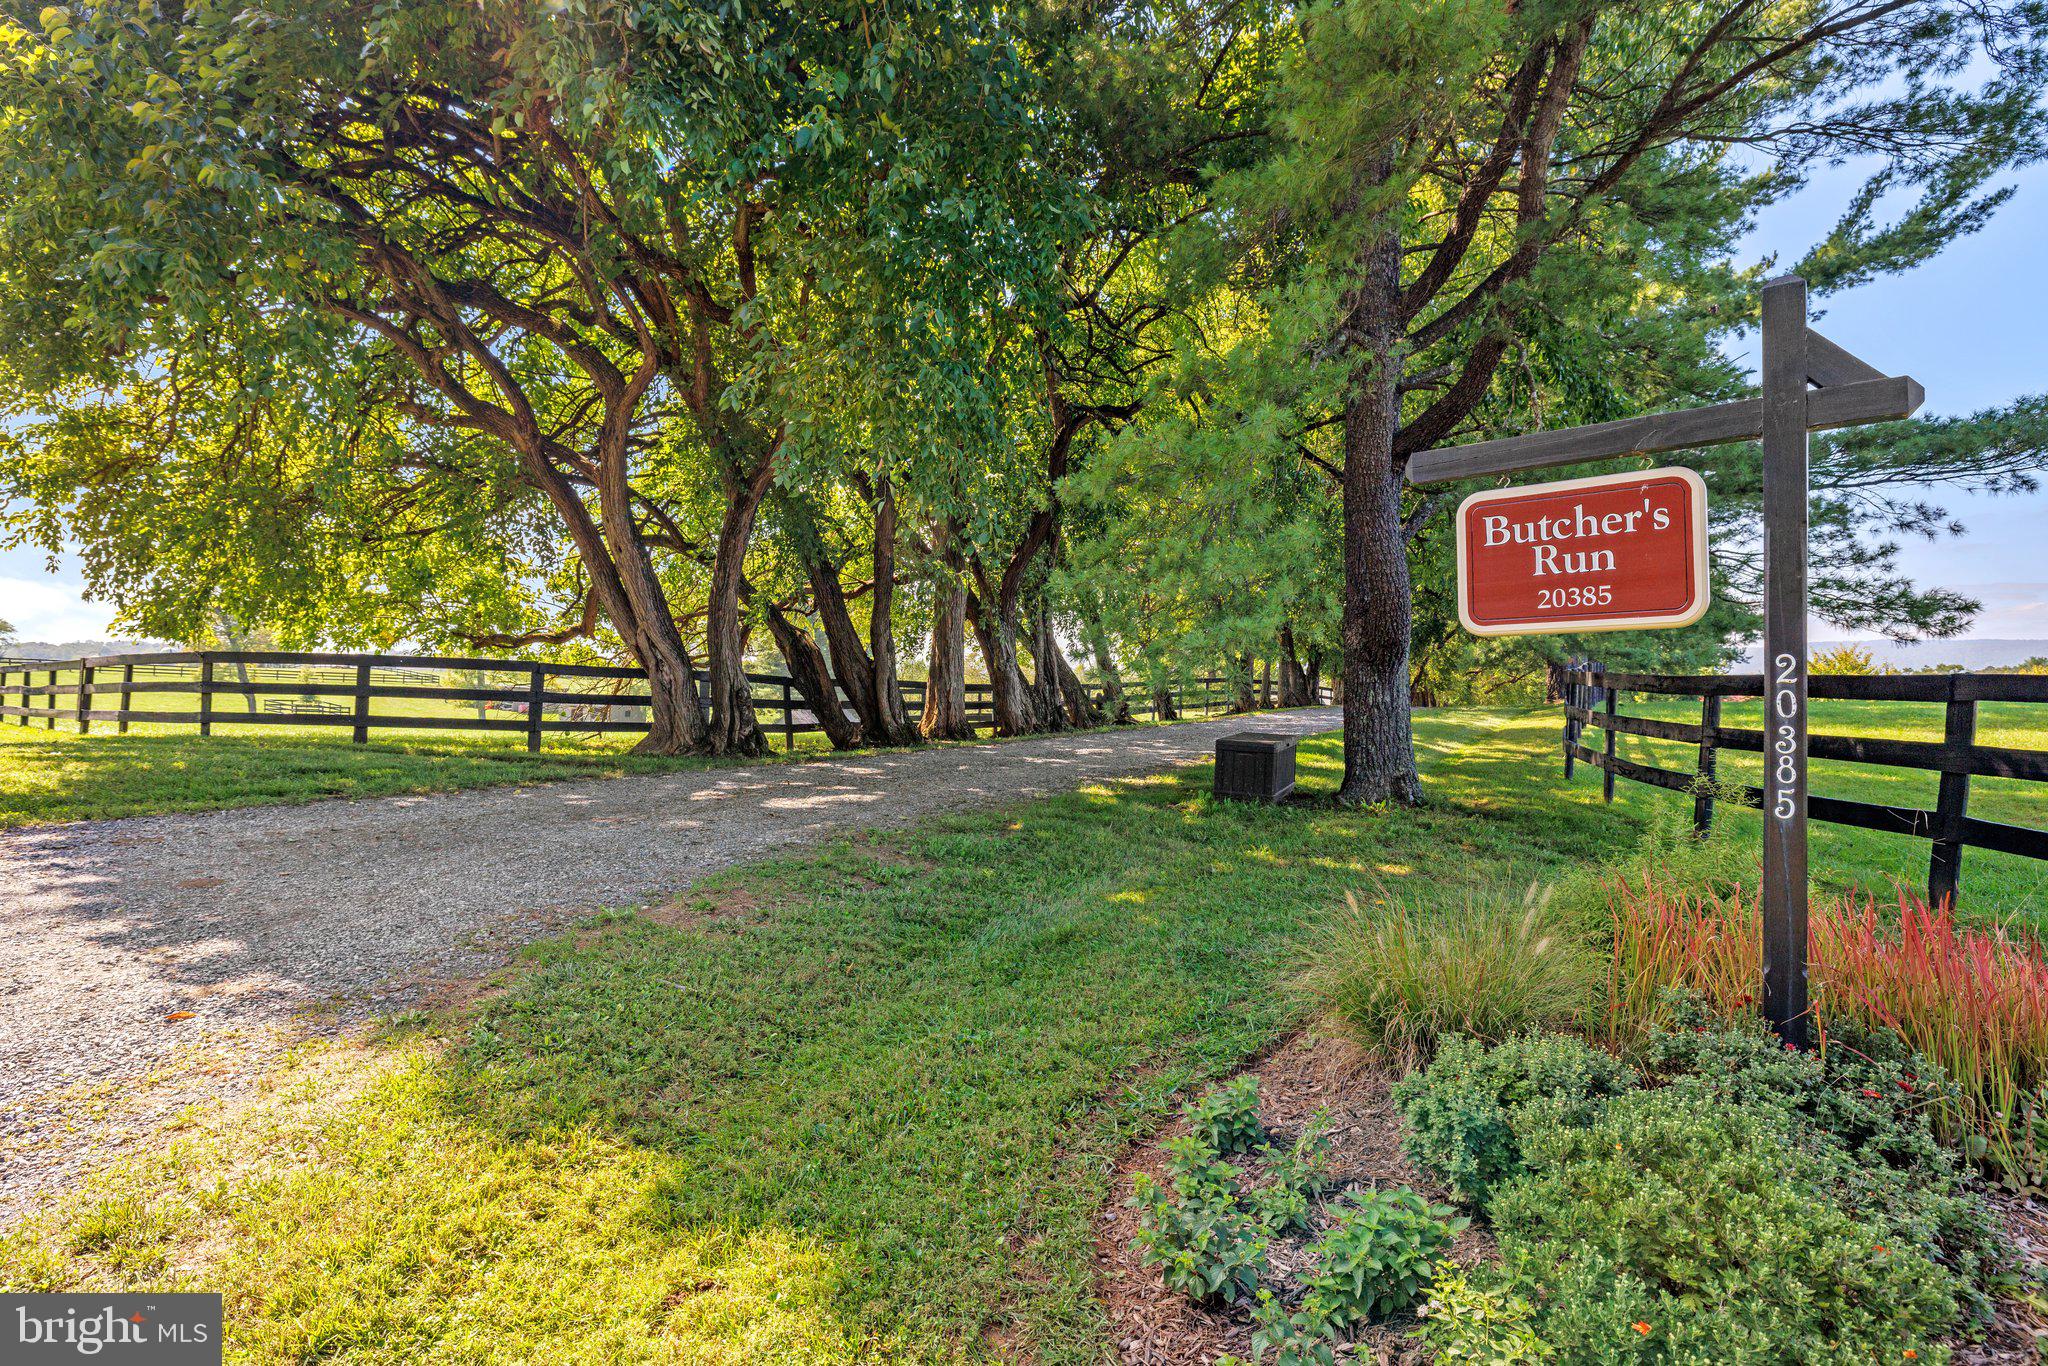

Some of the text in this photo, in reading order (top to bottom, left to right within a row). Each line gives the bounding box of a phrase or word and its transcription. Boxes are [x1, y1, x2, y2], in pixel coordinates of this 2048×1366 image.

[1482, 498, 1671, 547] Butcher's
[1532, 544, 1616, 577] Run
[1537, 584, 1612, 610] 20385
[1774, 653, 1797, 819] 20385
